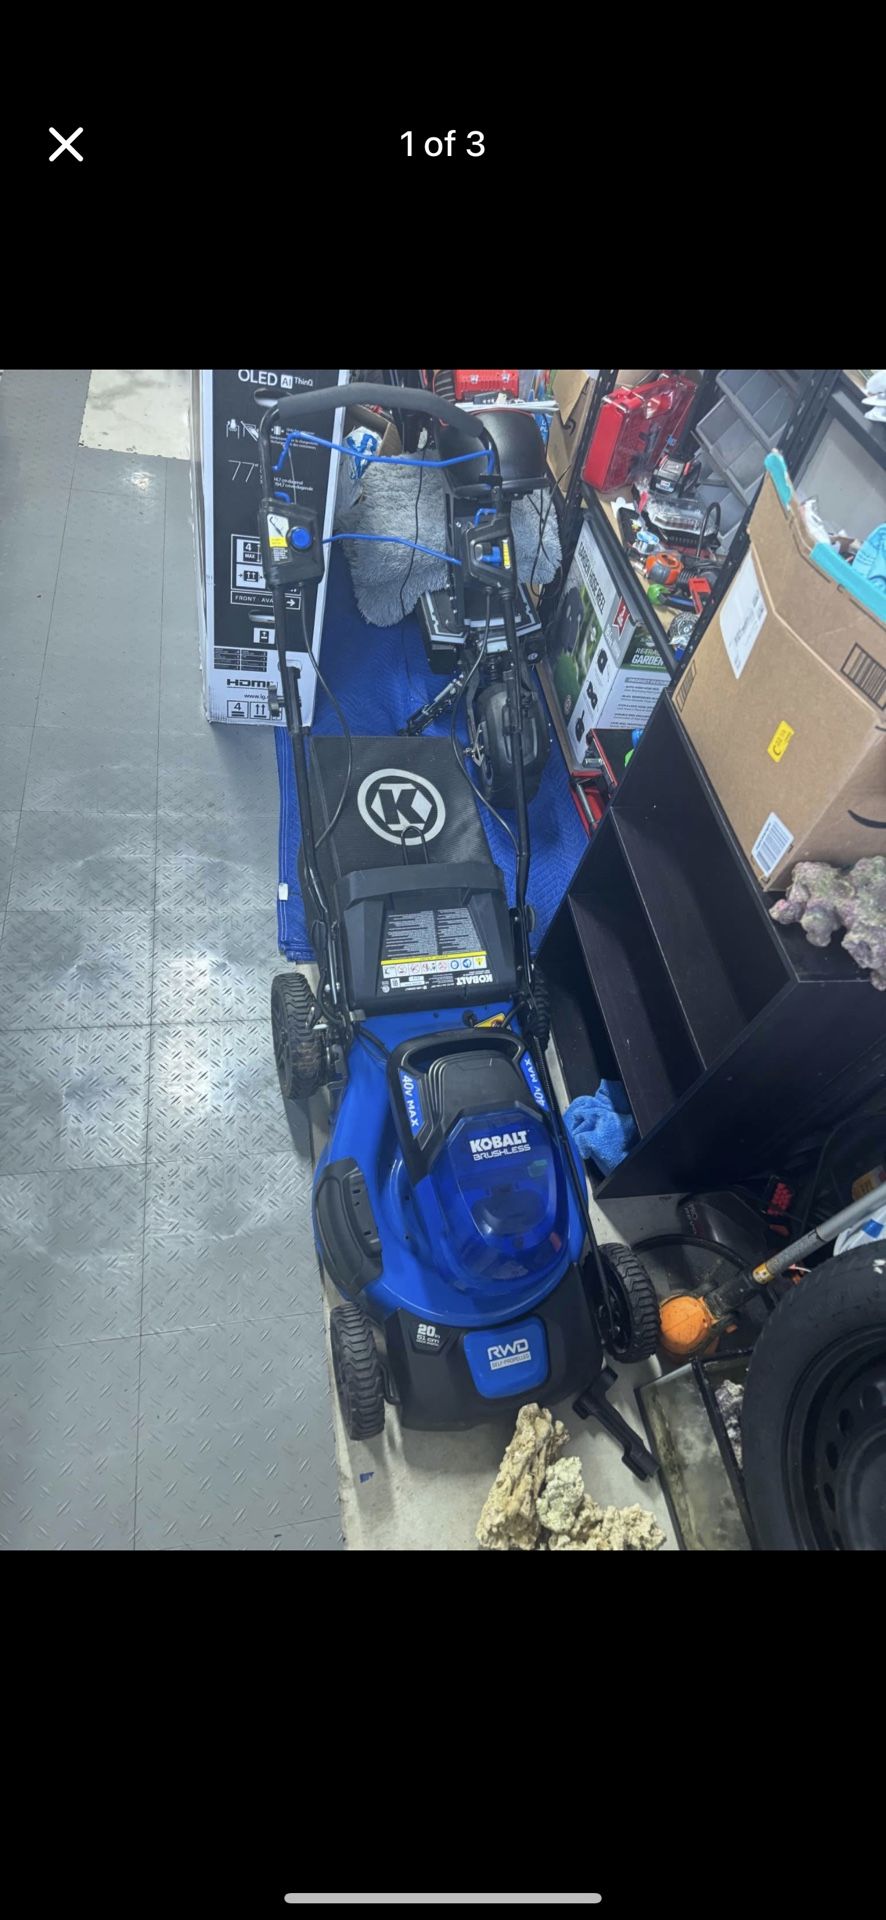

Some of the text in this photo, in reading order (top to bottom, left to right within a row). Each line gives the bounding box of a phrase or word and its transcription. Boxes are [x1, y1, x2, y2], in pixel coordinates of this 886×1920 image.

[238, 370, 313, 389] OLED AI ThinQ
[245, 543, 252, 552] 4
[578, 541, 606, 615] GARDEN HOSE REEL
[234, 702, 241, 710] 4
[456, 973, 493, 986] KOBALT
[524, 1058, 538, 1083] MAX
[406, 1099, 419, 1127] MAX
[469, 1130, 528, 1154] KOBALT
[473, 1144, 531, 1161] BRUSHLESS
[417, 1323, 436, 1337] 20
[487, 1338, 529, 1360] RWD
